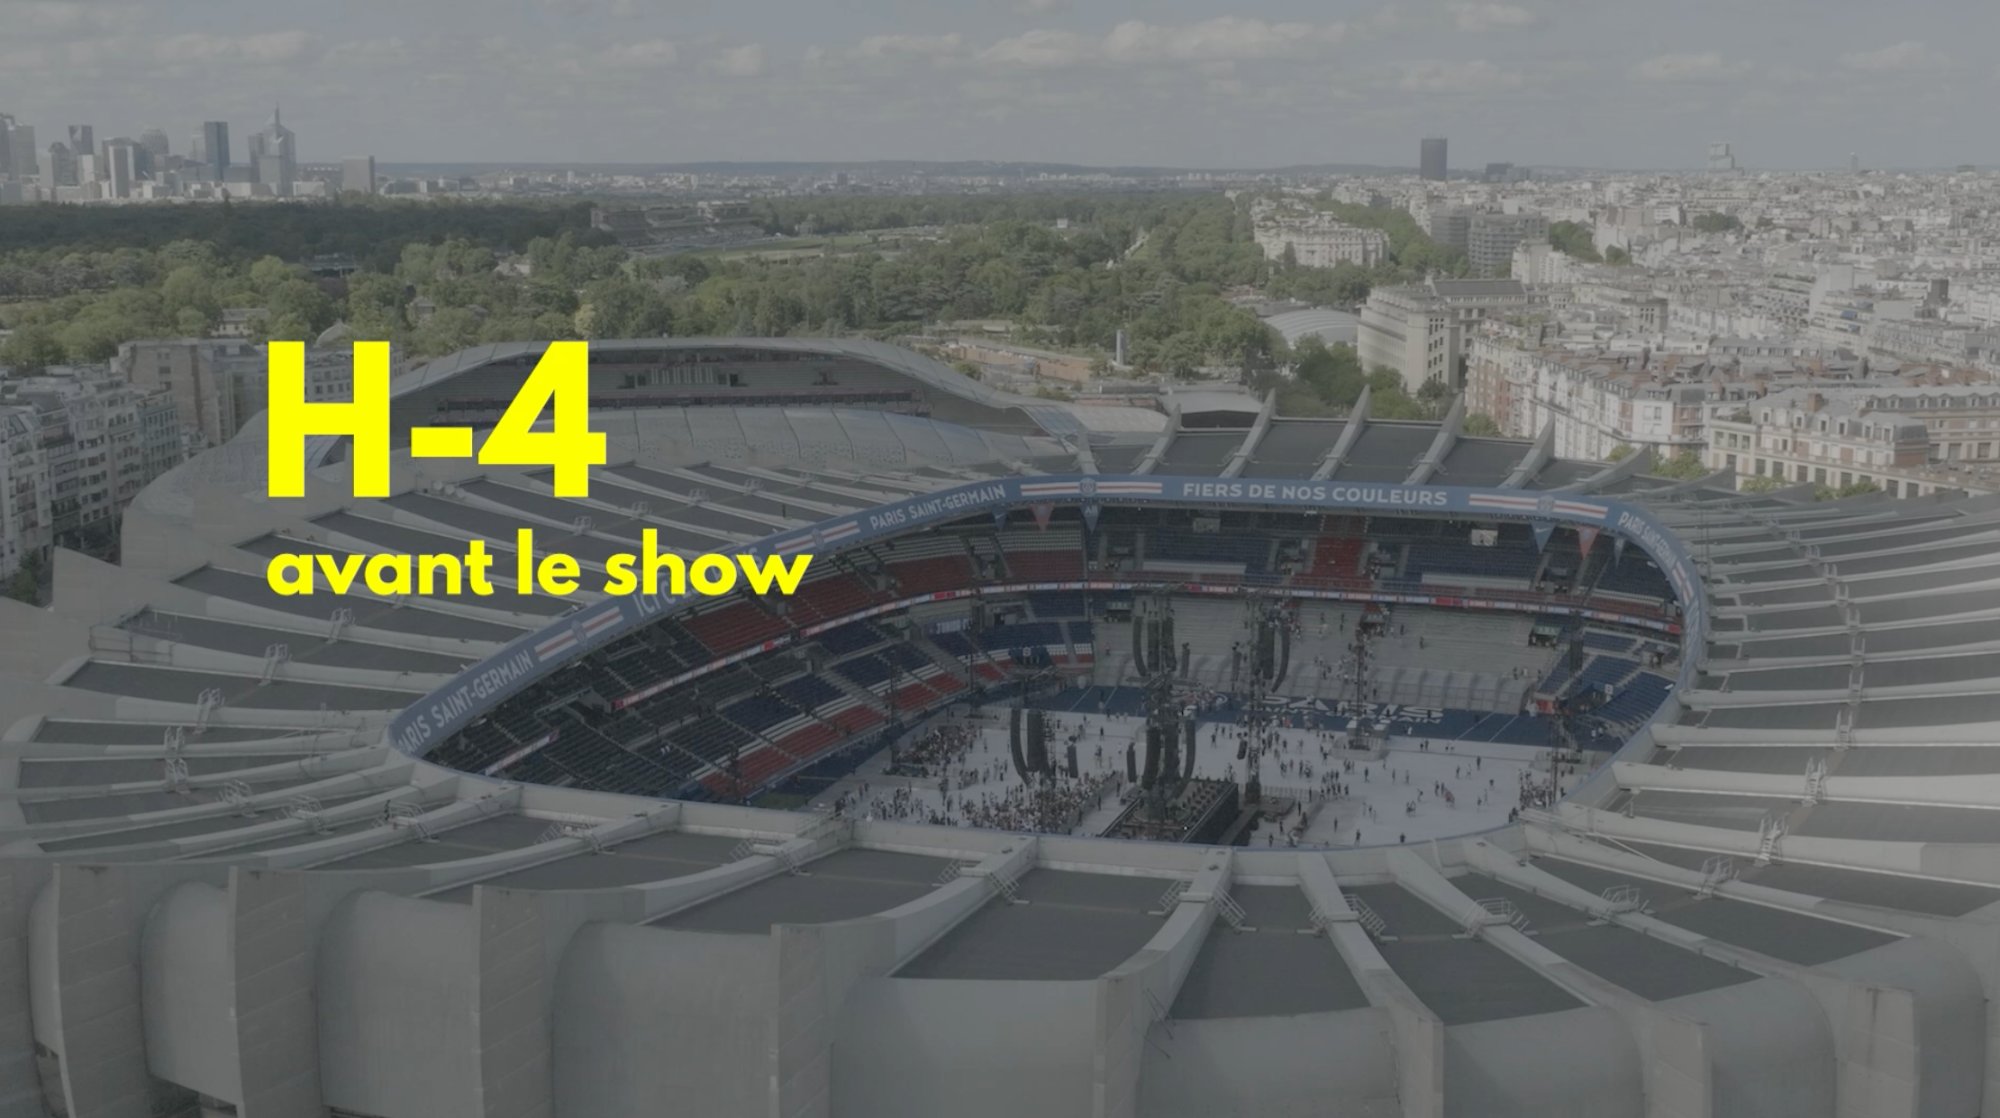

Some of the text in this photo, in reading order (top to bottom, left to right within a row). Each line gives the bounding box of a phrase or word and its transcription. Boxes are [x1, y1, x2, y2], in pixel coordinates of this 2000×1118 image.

[869, 484, 1007, 532] PARIS SAINT-GERMAIN
[1182, 482, 1448, 506] FIERS DE NOS COULEURS
[398, 649, 535, 752] ARIS SAINT-GERMAIN
